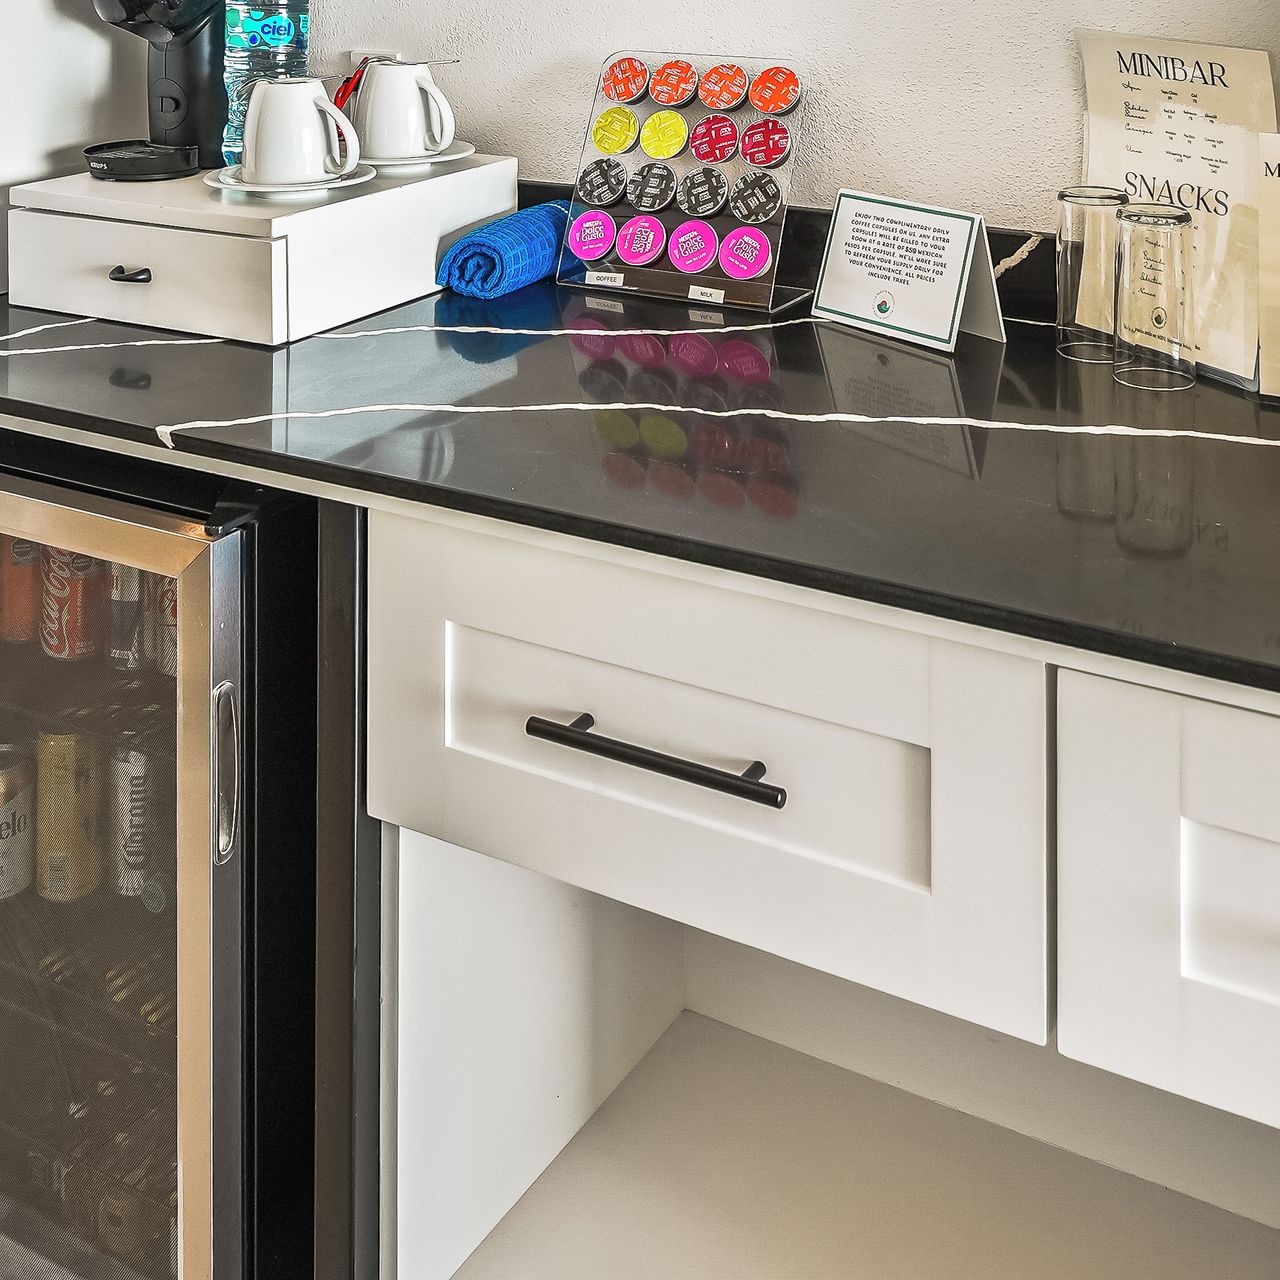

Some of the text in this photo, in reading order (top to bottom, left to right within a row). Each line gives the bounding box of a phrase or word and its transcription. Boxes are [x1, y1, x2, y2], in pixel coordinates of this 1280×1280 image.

[261, 21, 291, 36] ciel
[1116, 50, 1230, 89] MINIBAR
[1124, 171, 1229, 216] SNACKS
[581, 225, 604, 235] Dolce
[851, 219, 870, 228] COFFEE
[872, 223, 897, 233] CAPSULES
[932, 235, 950, 244] EXTRA
[873, 215, 885, 223] TWO
[886, 218, 932, 232] COMPLIMENTARY
[581, 232, 604, 242] Gusto
[678, 235, 703, 251] Dolce
[852, 227, 877, 237] CAPSULES
[901, 237, 919, 245] BILLED
[930, 243, 946, 251] YOUR
[681, 241, 705, 257] Gusto
[733, 245, 755, 263] Gusto
[737, 239, 759, 257] Dolce
[844, 242, 860, 250] PESOS
[916, 257, 931, 265] MAKE
[932, 260, 947, 268] SURE
[882, 241, 896, 249] RATE
[917, 250, 943, 259] MEXICAN
[848, 258, 863, 266] YOUR
[916, 273, 935, 283] PRICES
[853, 252, 876, 261] REFRESH
[893, 260, 913, 269] SUPPLY
[914, 265, 931, 273] DAILY
[867, 271, 891, 281] INCLUDE
